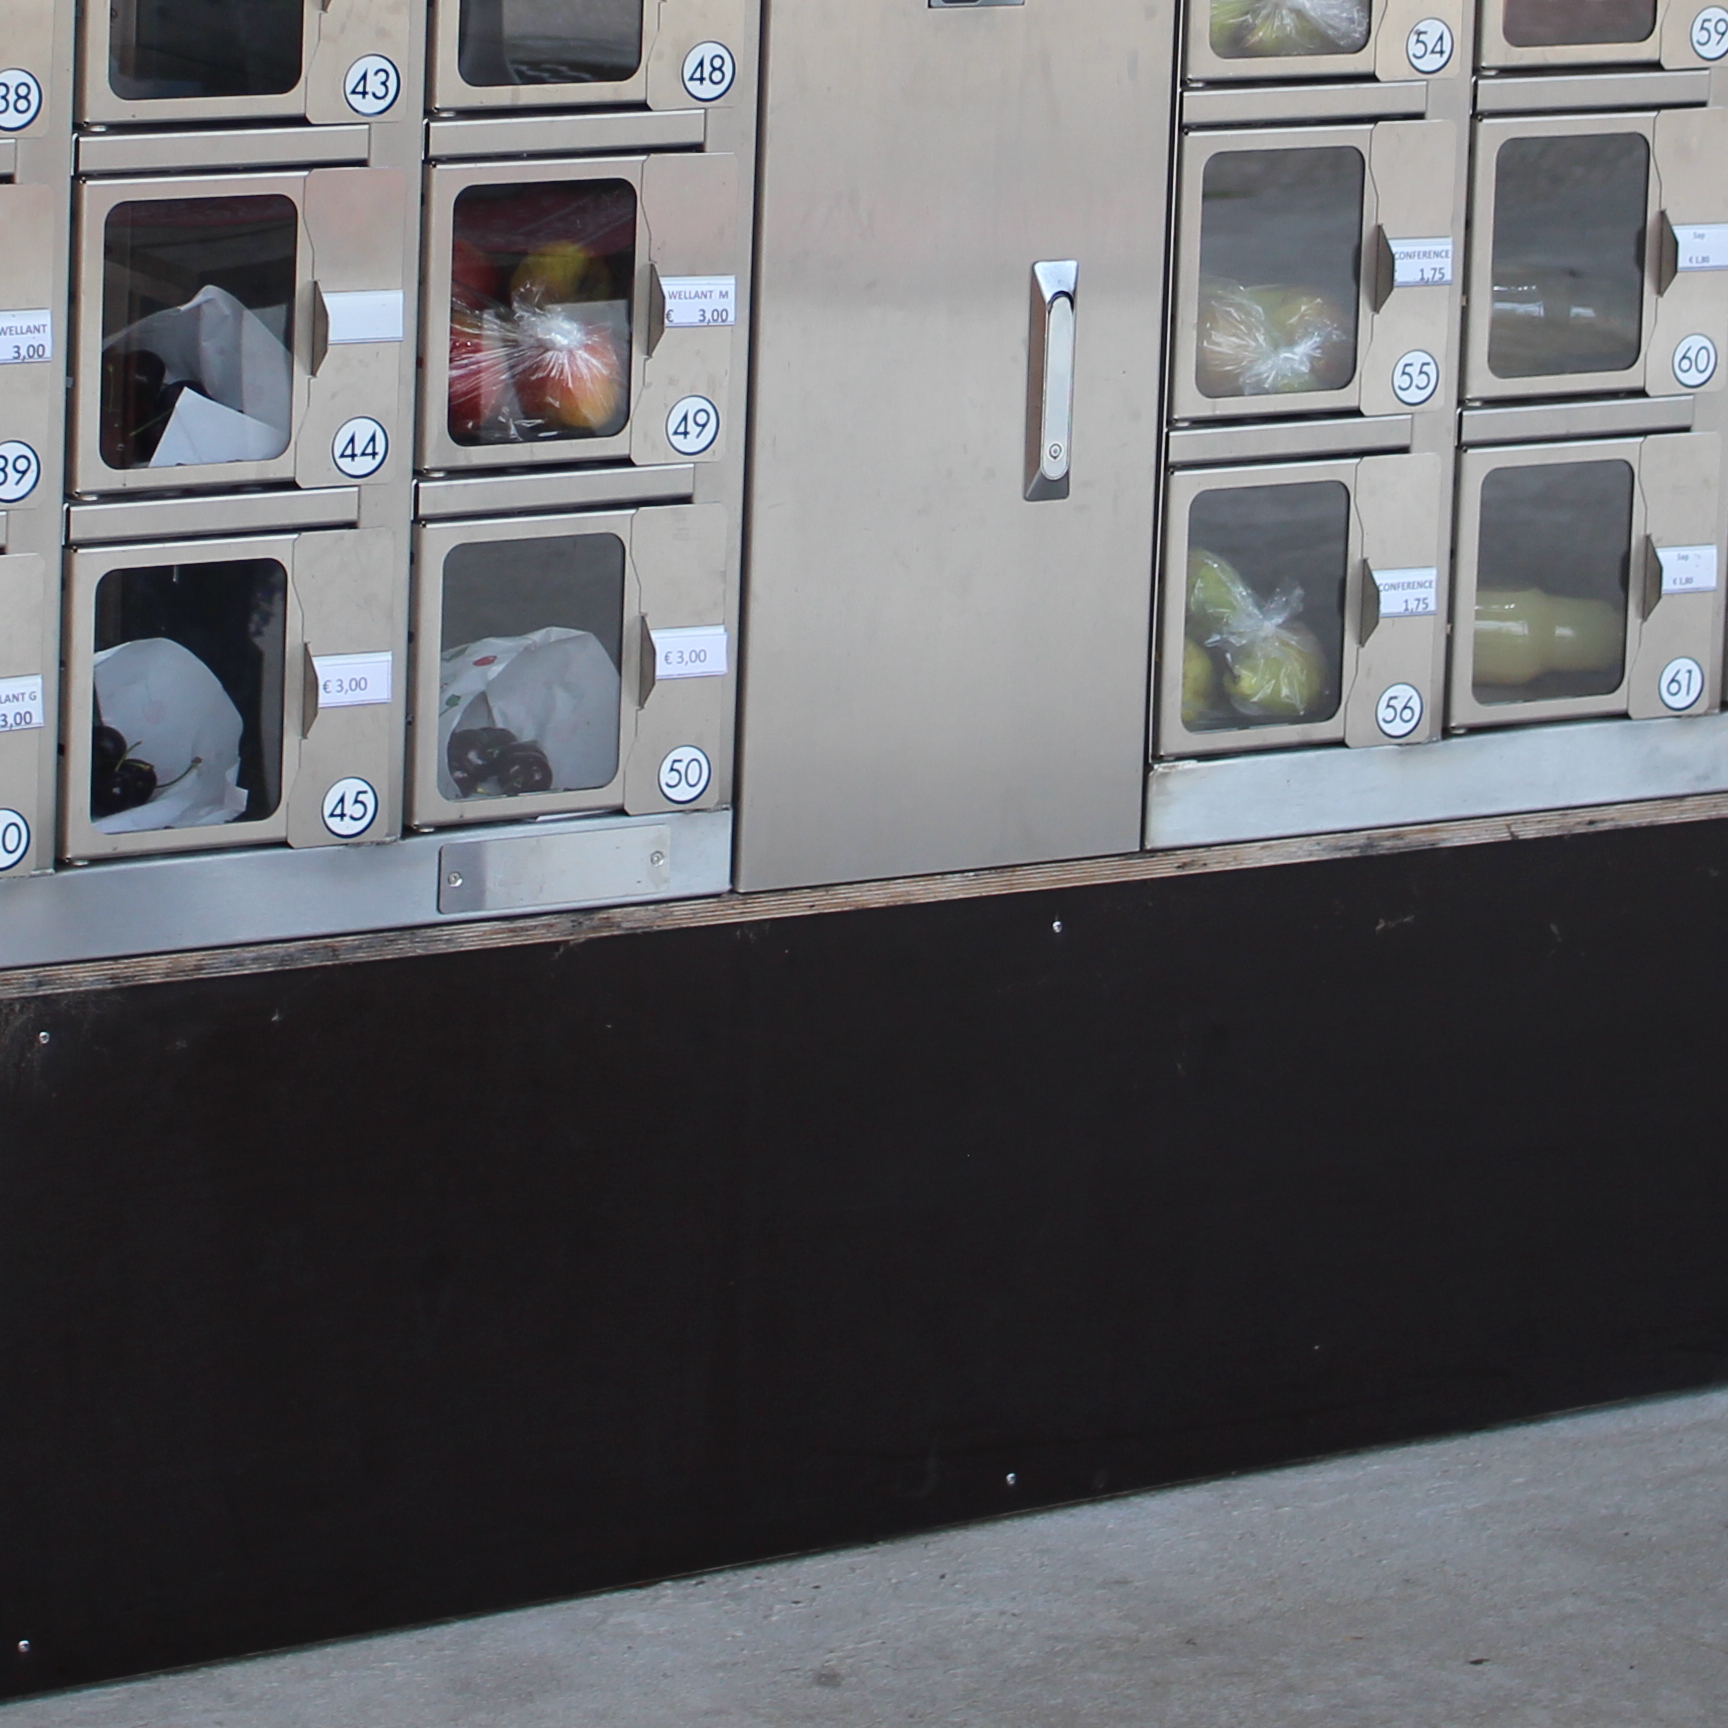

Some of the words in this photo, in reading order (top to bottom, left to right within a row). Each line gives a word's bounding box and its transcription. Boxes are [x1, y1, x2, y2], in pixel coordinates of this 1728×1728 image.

[1419, 267, 1445, 282] 1,75
[12, 344, 45, 362] 3,00
[1678, 346, 1710, 374] 60
[1398, 362, 1430, 391] 55
[339, 431, 378, 461] 44
[322, 680, 332, 693] €
[335, 677, 367, 695] 3,00
[665, 758, 702, 788] 50
[328, 791, 367, 821] 45
